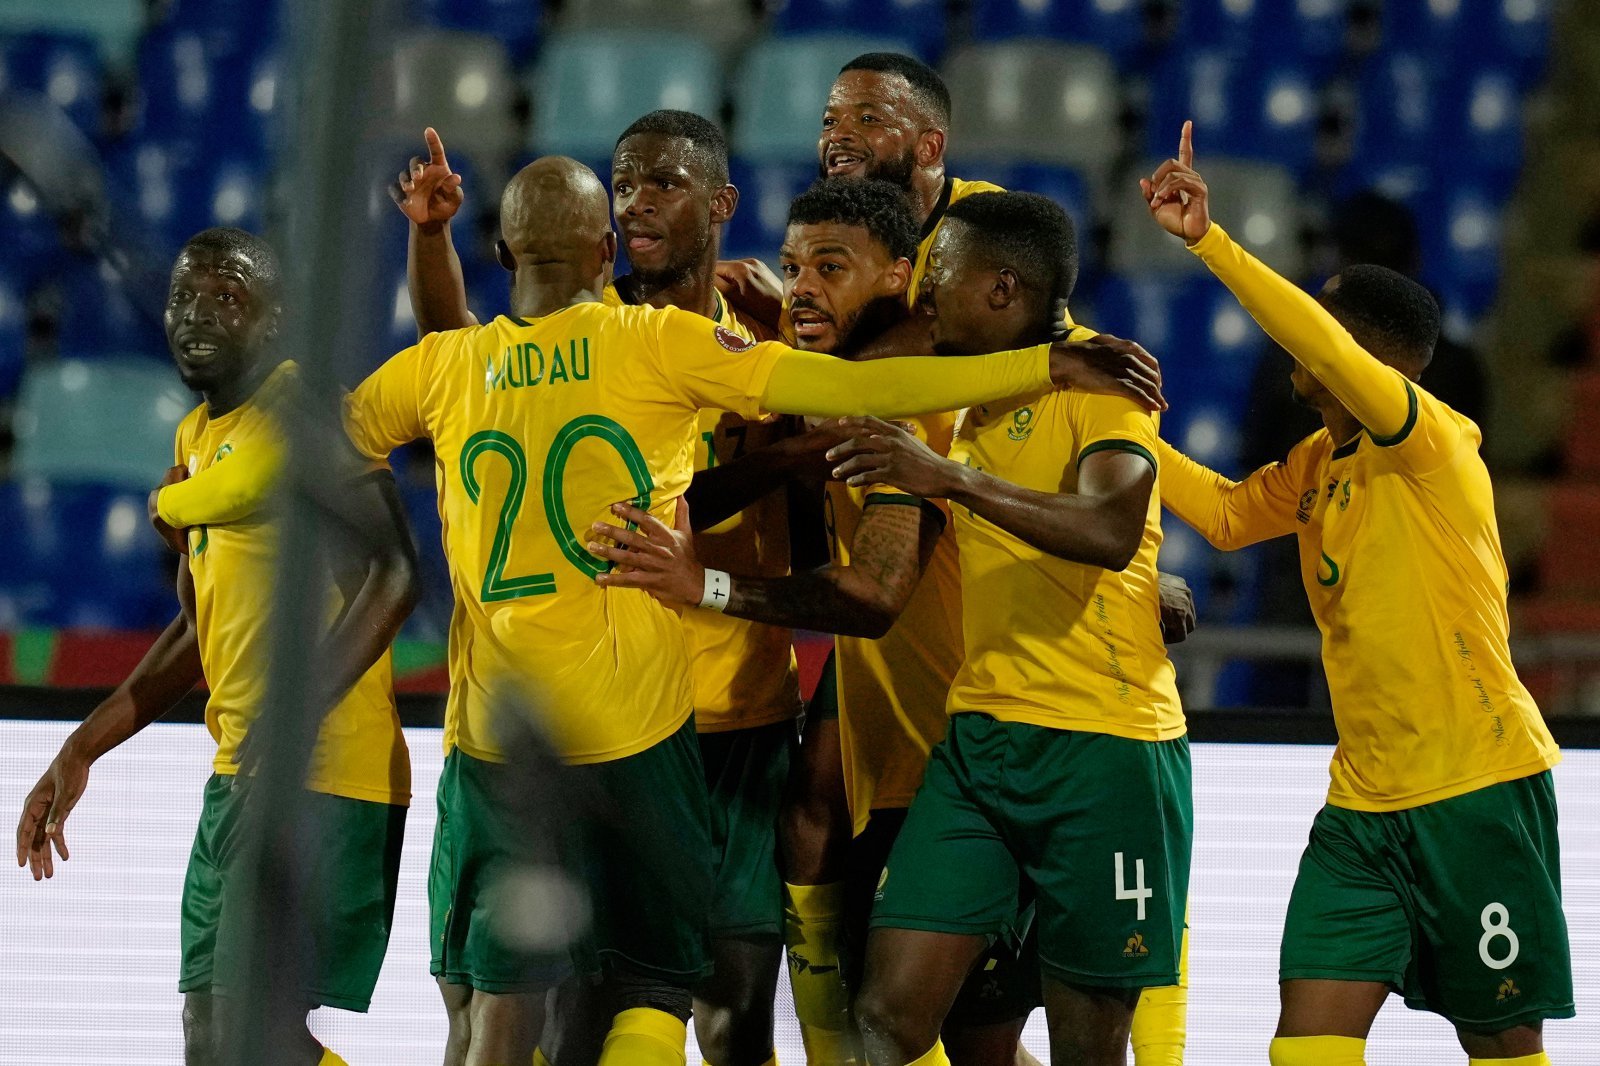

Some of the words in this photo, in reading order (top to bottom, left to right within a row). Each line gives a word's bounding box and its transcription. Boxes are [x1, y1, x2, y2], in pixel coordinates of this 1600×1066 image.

[485, 337, 590, 394] MUDAU
[459, 414, 654, 603] 20
[1114, 851, 1153, 921] 4
[1478, 902, 1520, 970] 8
